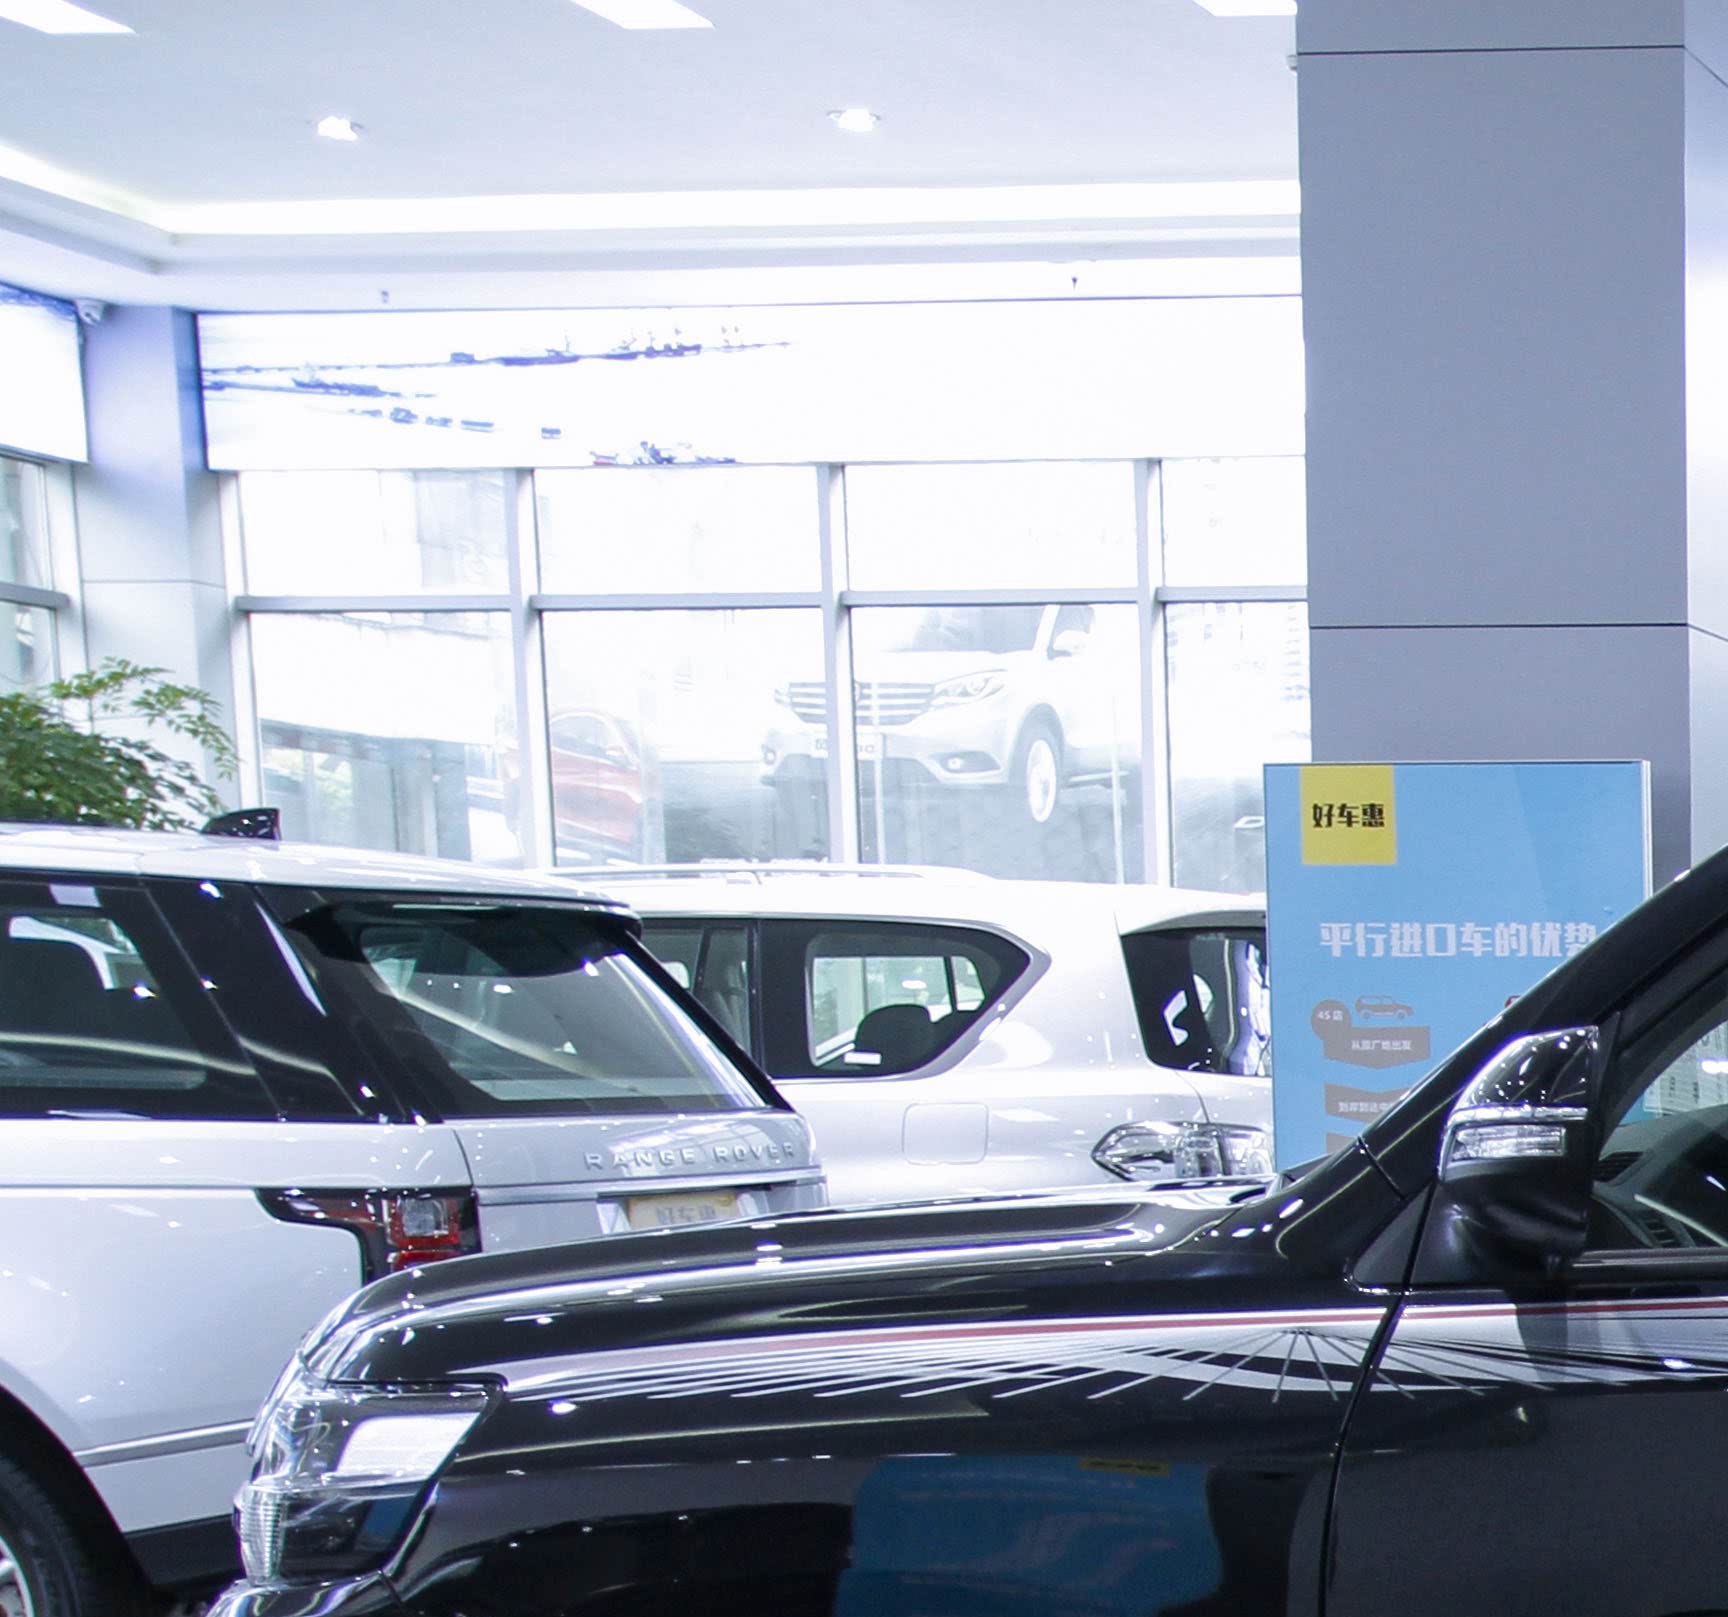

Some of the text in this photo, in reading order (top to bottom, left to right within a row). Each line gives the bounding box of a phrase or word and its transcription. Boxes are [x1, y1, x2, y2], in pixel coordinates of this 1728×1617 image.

[1312, 803, 1385, 828] 好车惠
[1320, 922, 1597, 958] 平行进口车的优势
[584, 1142, 796, 1171] RANGE ROVER
